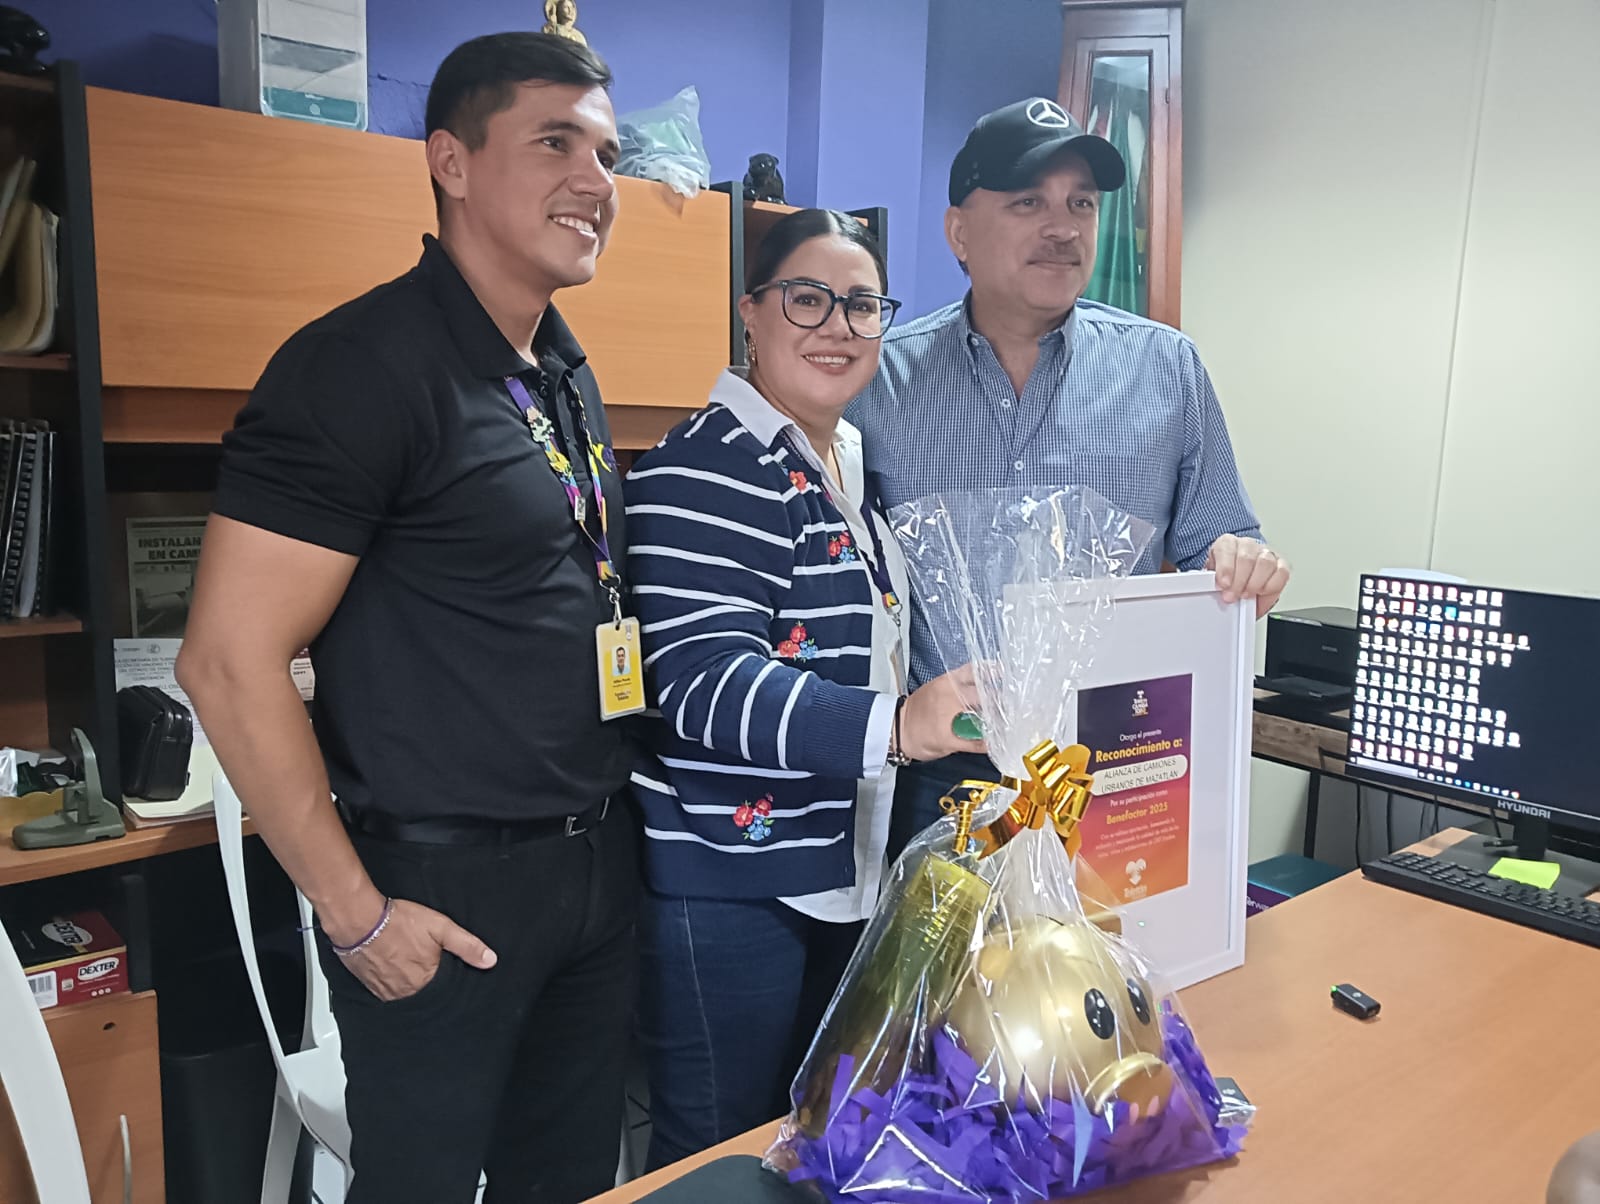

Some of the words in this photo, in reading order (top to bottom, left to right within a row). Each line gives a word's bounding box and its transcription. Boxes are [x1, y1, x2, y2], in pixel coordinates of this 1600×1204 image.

[148, 550, 166, 560] EN
[1095, 740, 1171, 763] Reconocimiento
[1172, 738, 1183, 748] a:
[1104, 767, 1132, 779] ALIANZA
[1132, 765, 1142, 774] DE
[1143, 758, 1176, 771] CAMIONES
[1101, 779, 1133, 793] URBANOS
[1135, 778, 1145, 786] DE
[1106, 809, 1148, 825] Benefactor
[1497, 800, 1551, 819] HYUNDAI
[79, 961, 116, 976] DEXTER
